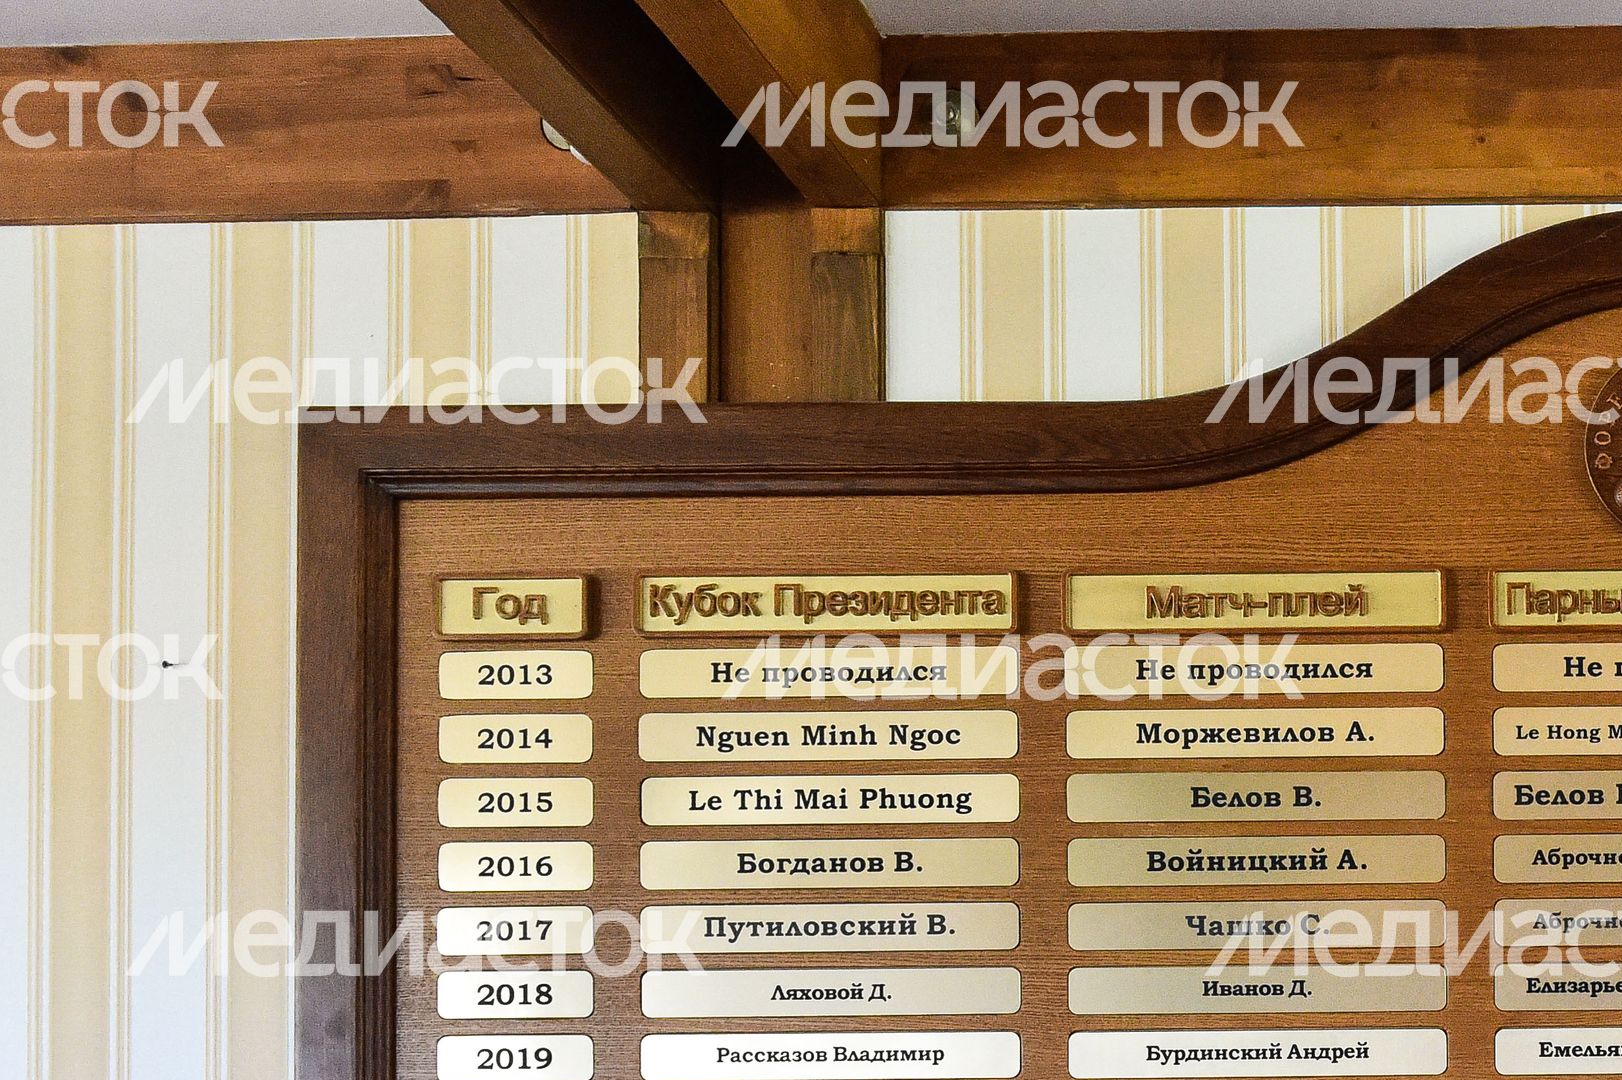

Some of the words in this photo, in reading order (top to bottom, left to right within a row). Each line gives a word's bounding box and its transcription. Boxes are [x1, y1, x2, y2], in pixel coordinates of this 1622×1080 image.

[472, 586, 549, 625] Год
[649, 583, 762, 627] Кубок
[773, 583, 1007, 624] Президента
[1144, 584, 1370, 619] Матч-плей
[477, 663, 553, 686] 2013
[710, 661, 750, 683] Не
[761, 665, 947, 689] проводился
[1135, 659, 1176, 681] Не
[1187, 662, 1374, 686] проводился
[1563, 656, 1603, 678] Не
[477, 727, 553, 750] 2014
[695, 725, 790, 754] Nguen
[800, 723, 878, 747] Minh
[888, 724, 961, 752] Ngoc
[1135, 722, 1335, 750] Моржевилов
[1344, 720, 1375, 742] А.
[1515, 724, 1540, 740] Le
[1546, 724, 1602, 744] Hong
[477, 791, 553, 814] 2015
[688, 790, 723, 811] Le
[732, 788, 784, 811] Thi
[793, 787, 849, 810] Mai
[858, 787, 973, 815] Phuong
[1189, 785, 1282, 809] Белов
[1292, 785, 1322, 808] В.
[1513, 784, 1605, 806] Белов
[477, 855, 553, 878] 2016
[736, 852, 885, 876] Богданов
[893, 851, 923, 873] В.
[1146, 847, 1329, 874] Войницкий
[1336, 848, 1368, 871] А.
[476, 919, 553, 942] 2017
[703, 912, 918, 944] Путиловский
[926, 913, 956, 936] В.
[1184, 914, 1291, 937] Чашко
[1300, 913, 1331, 936] С.
[476, 983, 553, 1006] 2018
[770, 982, 865, 1001] Ляховой
[867, 983, 892, 1003] Д.
[1201, 980, 1285, 997] Иванов
[1287, 979, 1313, 999] Д.
[476, 1047, 553, 1070] 2019
[716, 1047, 828, 1063] Рассказов
[832, 1046, 945, 1066] Владимир
[1145, 1042, 1283, 1066] Бурдинский
[1286, 1041, 1370, 1064] Андрей
